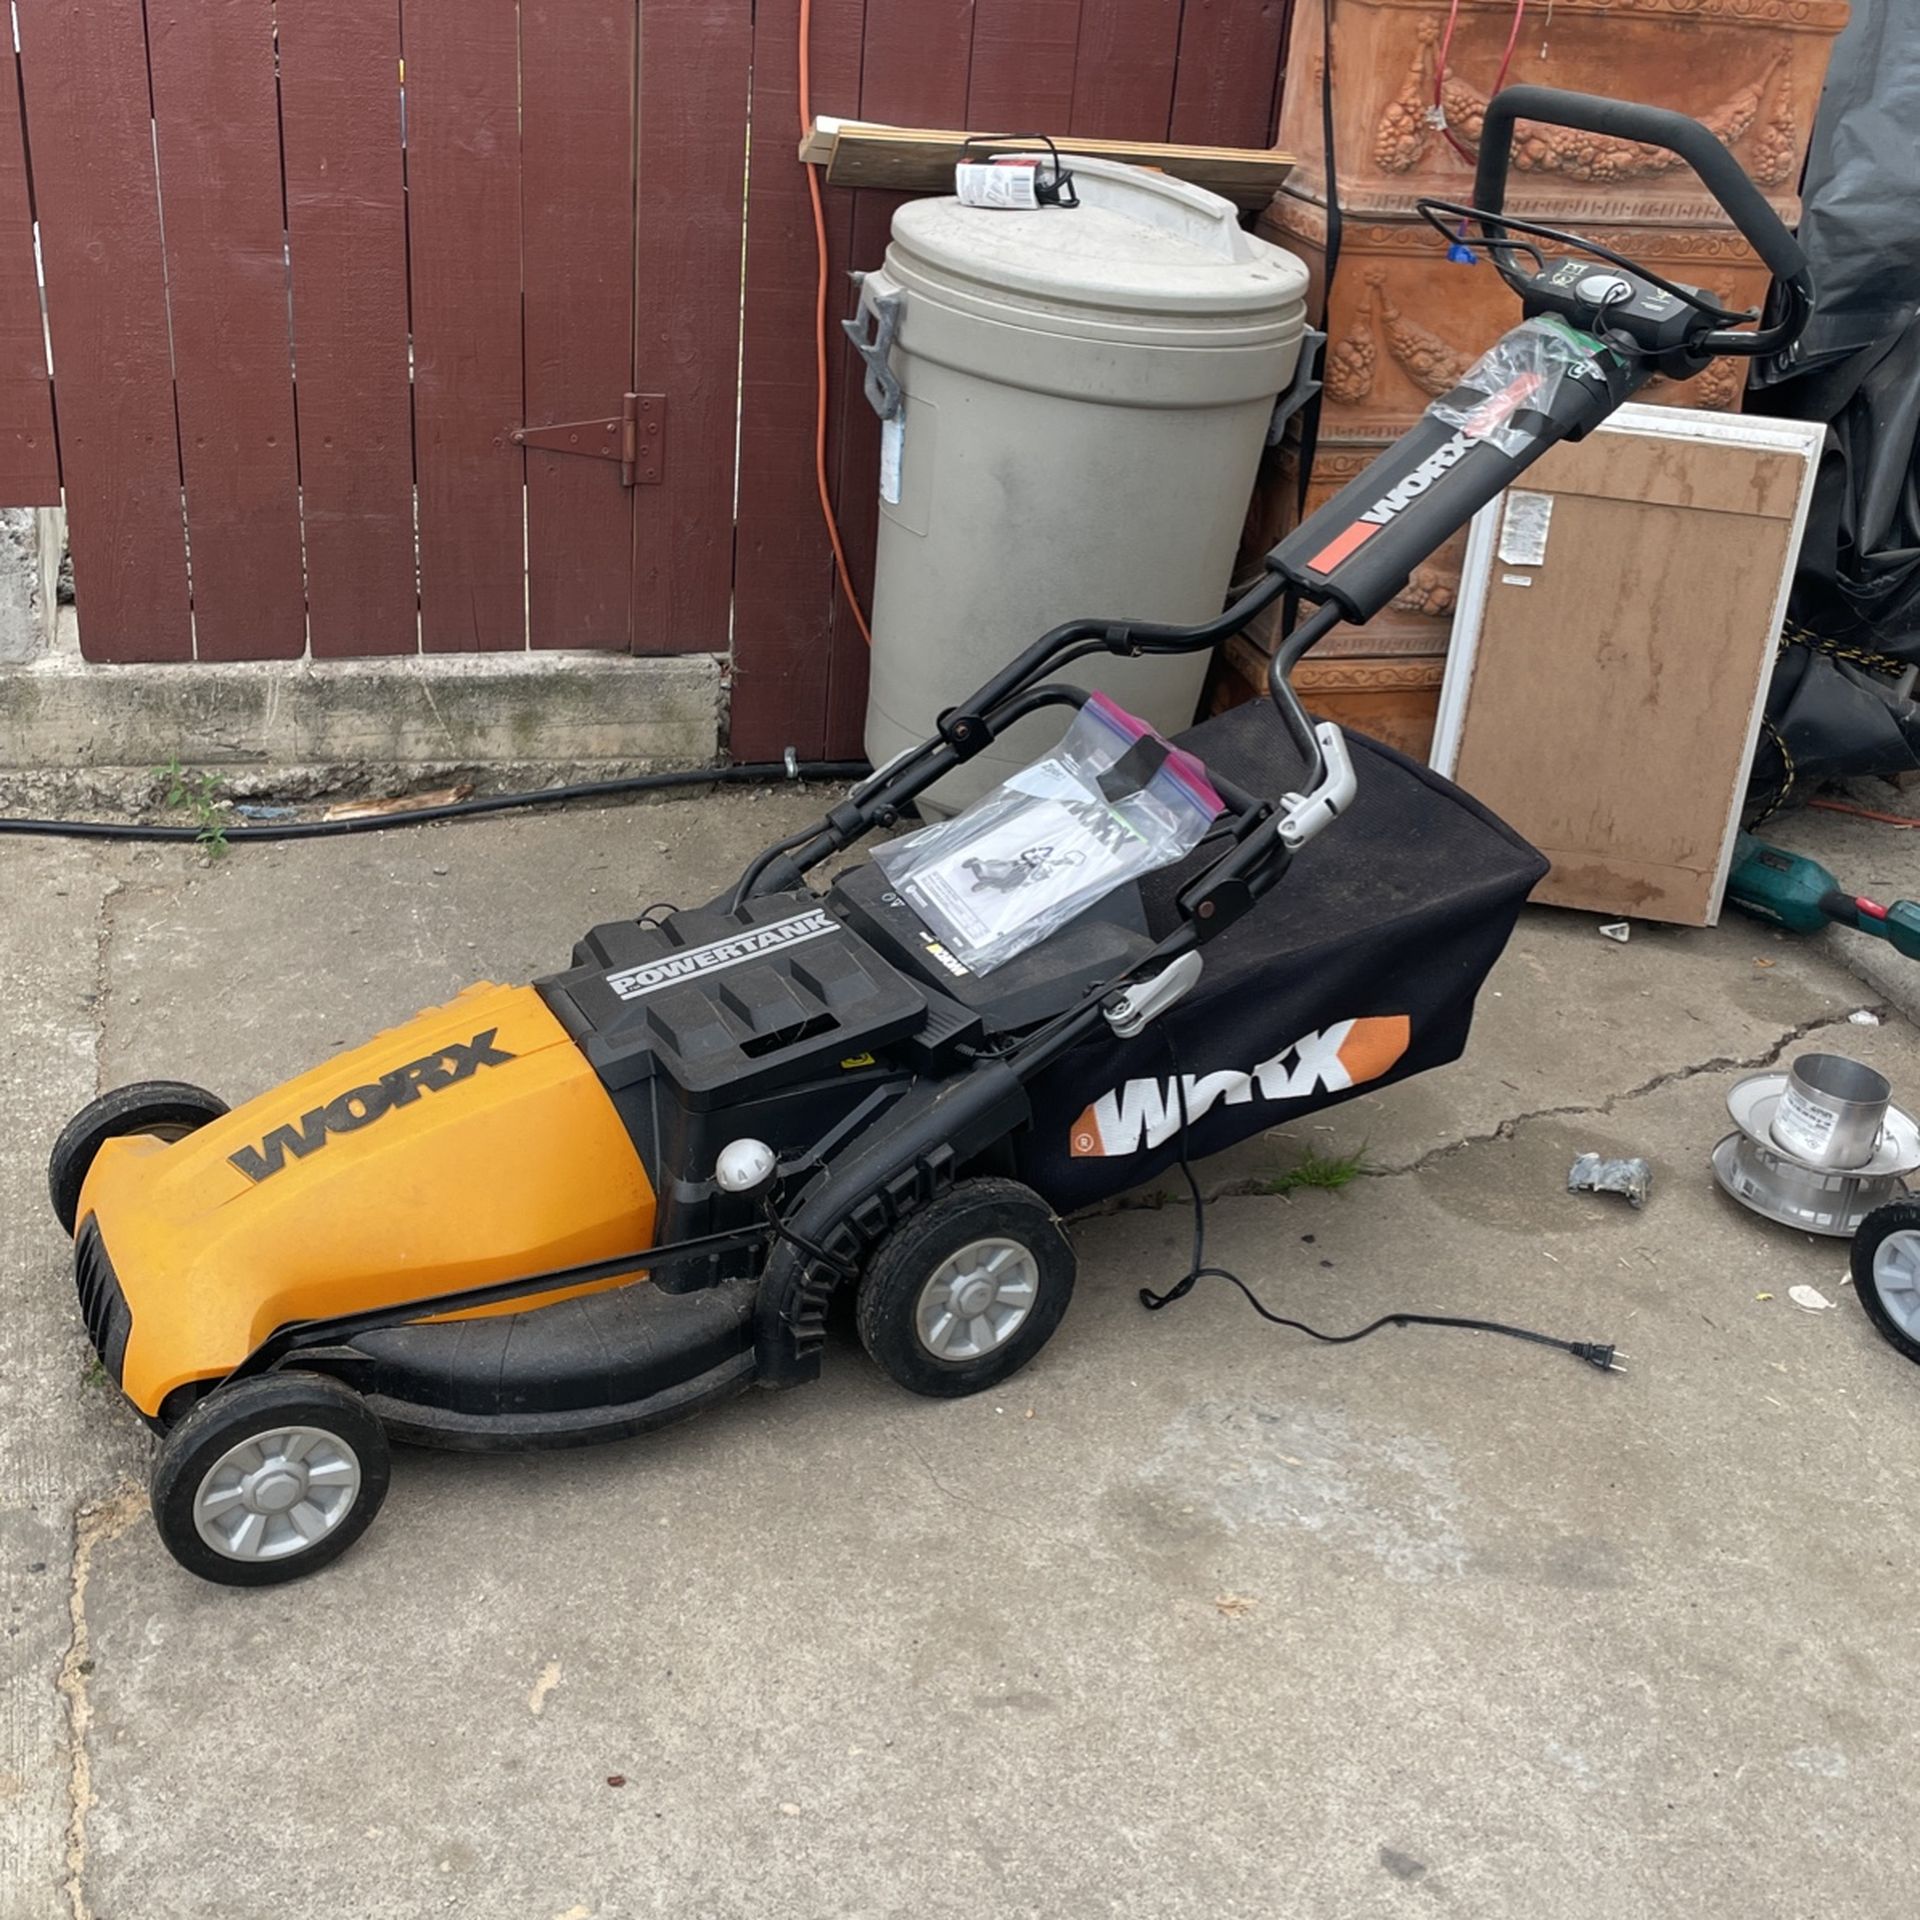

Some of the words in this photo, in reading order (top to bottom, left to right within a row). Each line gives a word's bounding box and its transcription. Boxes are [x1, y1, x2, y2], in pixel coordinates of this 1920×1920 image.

[1359, 430, 1480, 525] WORX
[609, 912, 836, 995] POWERTANK
[227, 1027, 518, 1183] WORX
